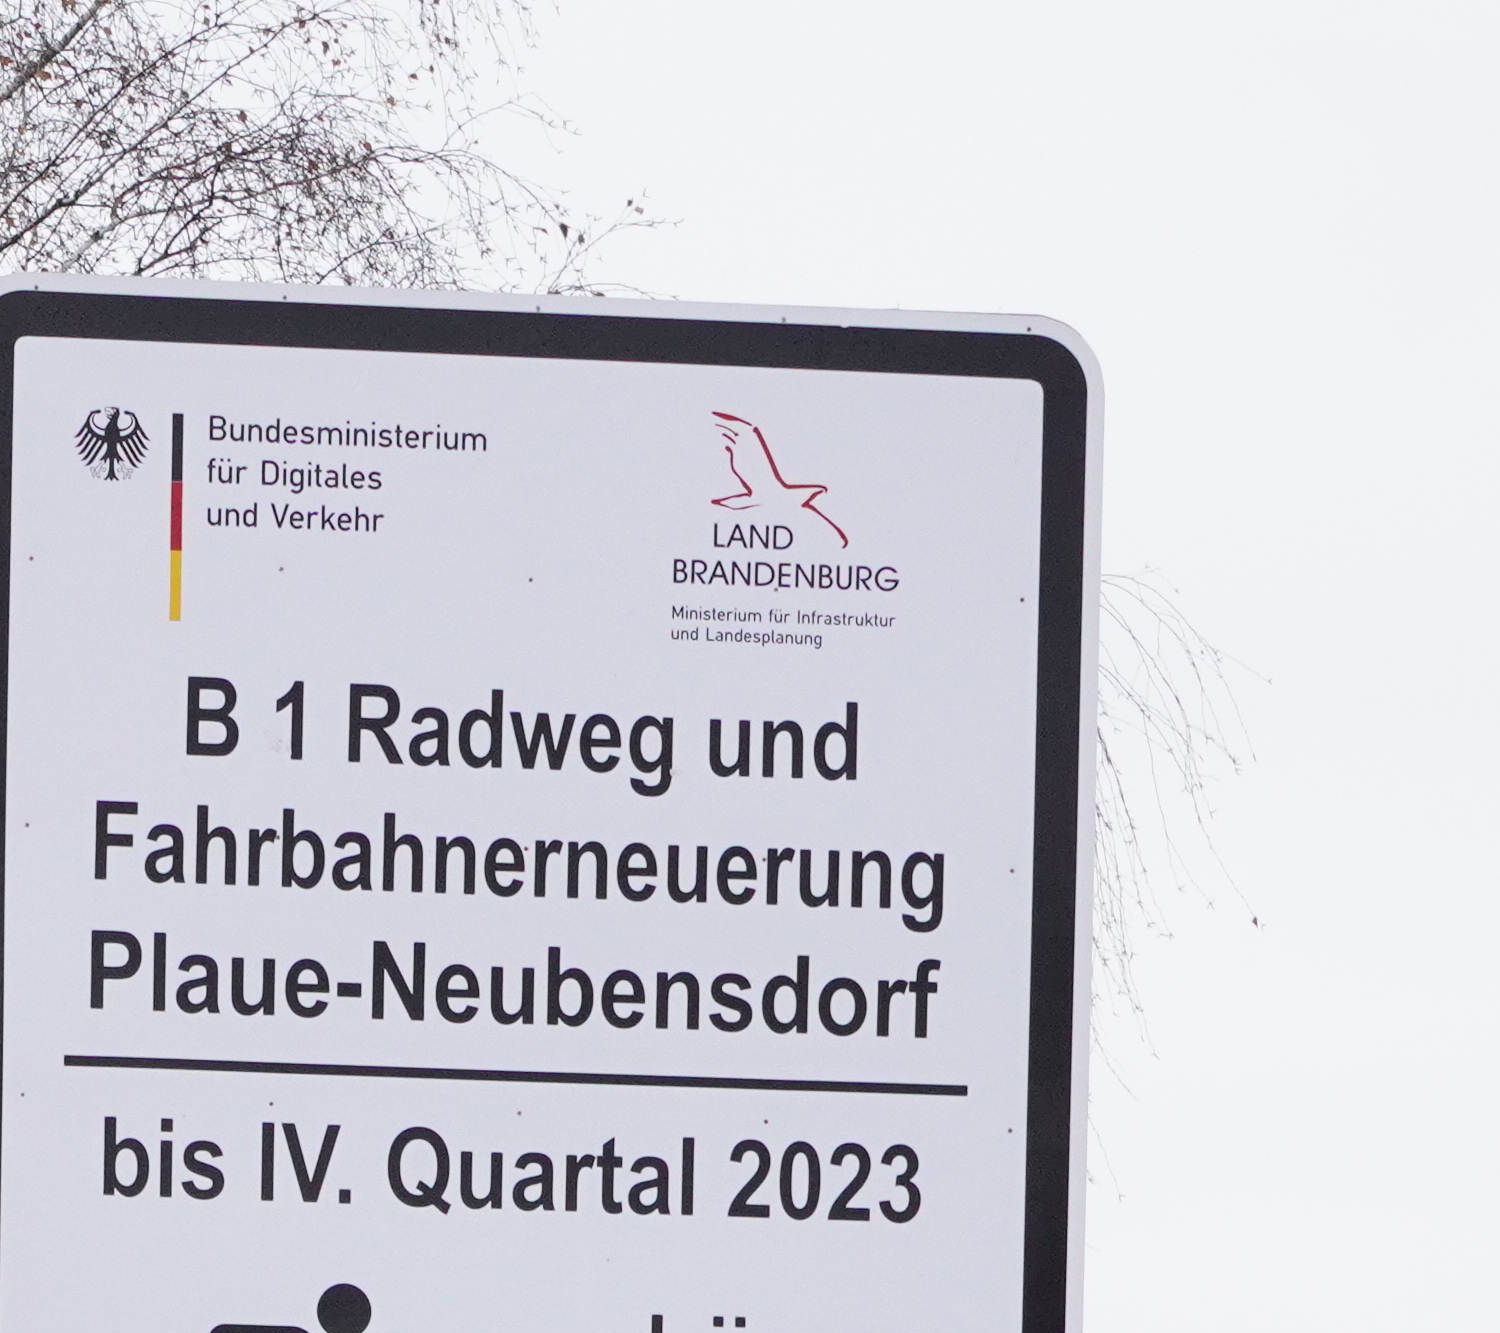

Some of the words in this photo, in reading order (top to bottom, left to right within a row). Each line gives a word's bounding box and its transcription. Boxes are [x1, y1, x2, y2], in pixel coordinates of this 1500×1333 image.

[209, 414, 487, 452] Bundesministerium
[207, 457, 248, 485] für
[261, 459, 382, 495] Digitales
[207, 502, 258, 528] und
[270, 502, 385, 532] Verkehr
[713, 522, 794, 550] LAND
[673, 558, 900, 592] BRANDENBURG
[671, 605, 762, 623] Ministerium
[768, 608, 792, 624] für
[797, 609, 896, 628] Infrastruktur
[670, 627, 699, 641] und
[706, 627, 823, 650] Landesplanung
[185, 675, 240, 757] B
[275, 680, 305, 761] 1
[348, 683, 674, 797] Radweg
[708, 701, 859, 782] und
[94, 799, 945, 934] Fahrbahnerneuerung
[90, 929, 942, 1039] Plaue-Neubensdorf
[102, 1116, 225, 1201] bis
[260, 1121, 352, 1205] IV.
[387, 1126, 695, 1216] Quartal
[727, 1139, 922, 1224] 2023
